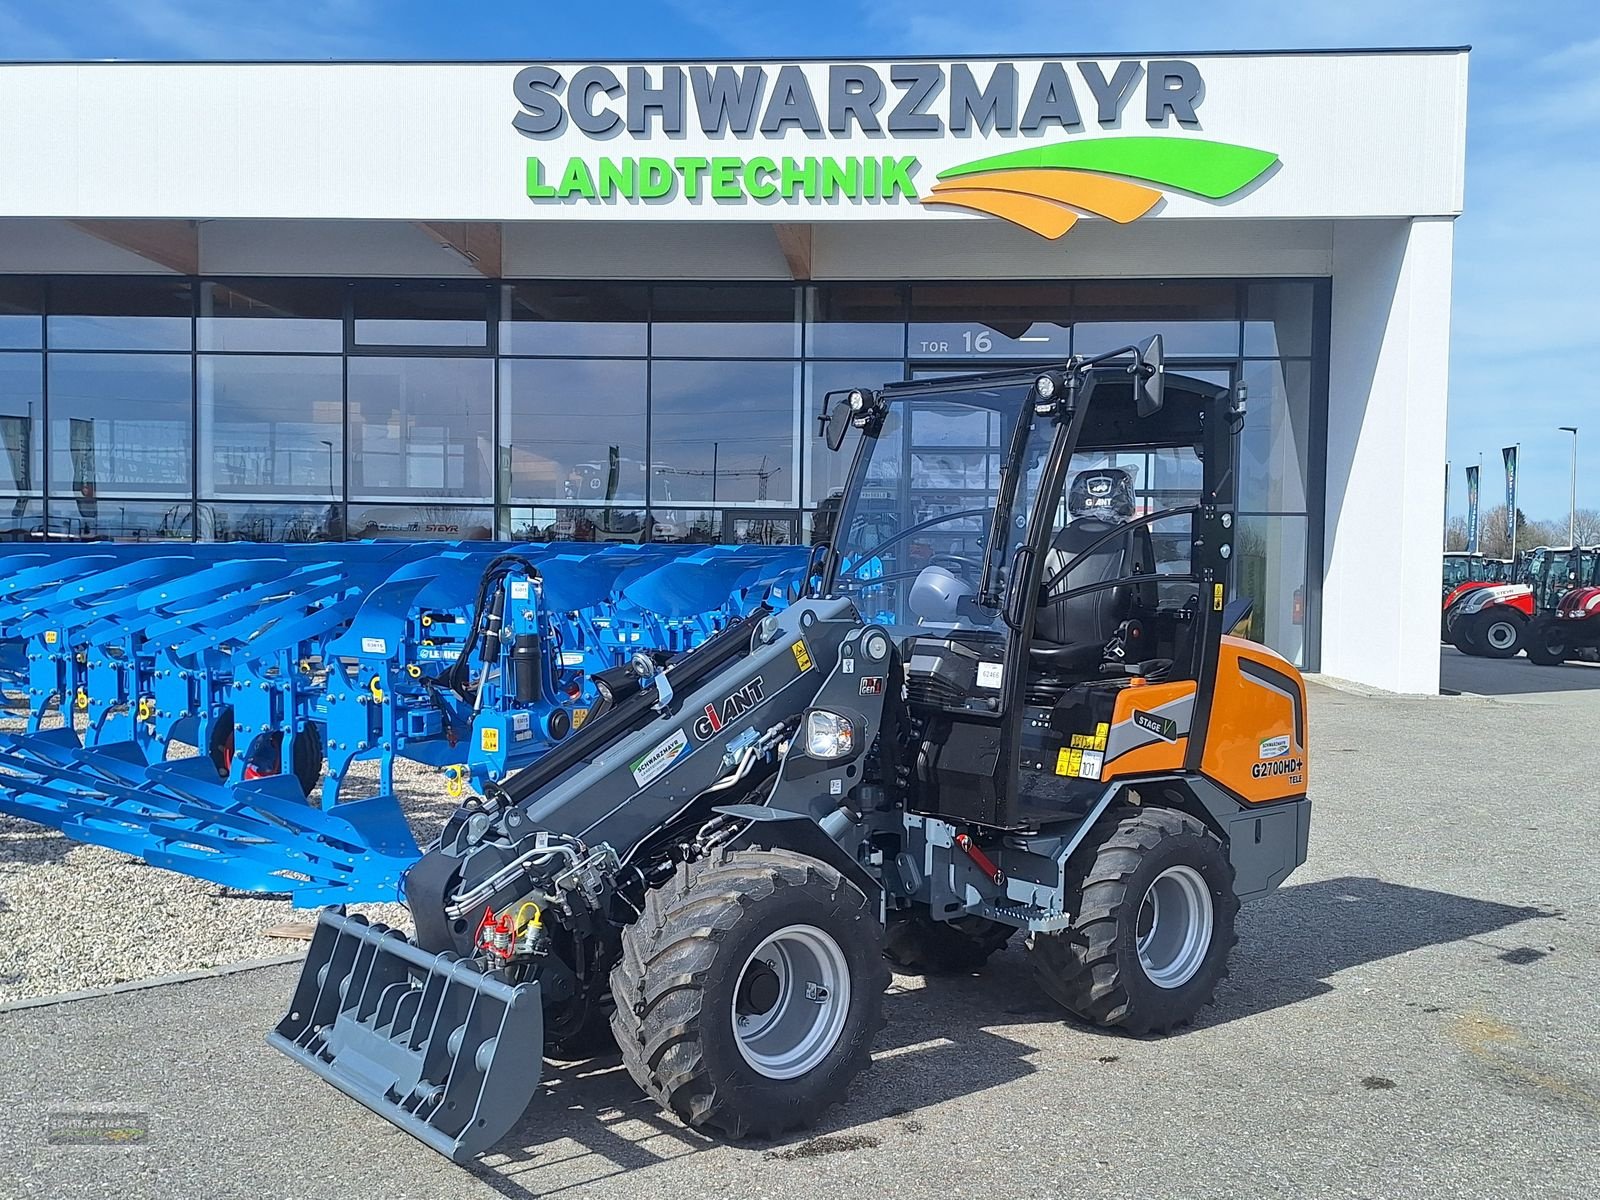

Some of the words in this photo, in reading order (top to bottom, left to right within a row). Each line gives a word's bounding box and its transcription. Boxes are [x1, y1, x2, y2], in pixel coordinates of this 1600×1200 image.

[512, 60, 1205, 138] SCHWARZMAYR
[526, 156, 919, 202] LANDTECHNIK
[920, 341, 949, 353] TOR
[963, 331, 993, 353] 16
[425, 524, 459, 533] STEYR
[1138, 716, 1162, 732] STAGE
[637, 739, 679, 774] SCHWARZMAYR
[1251, 757, 1303, 779] G2700HD+
[1288, 774, 1303, 785] TELE
